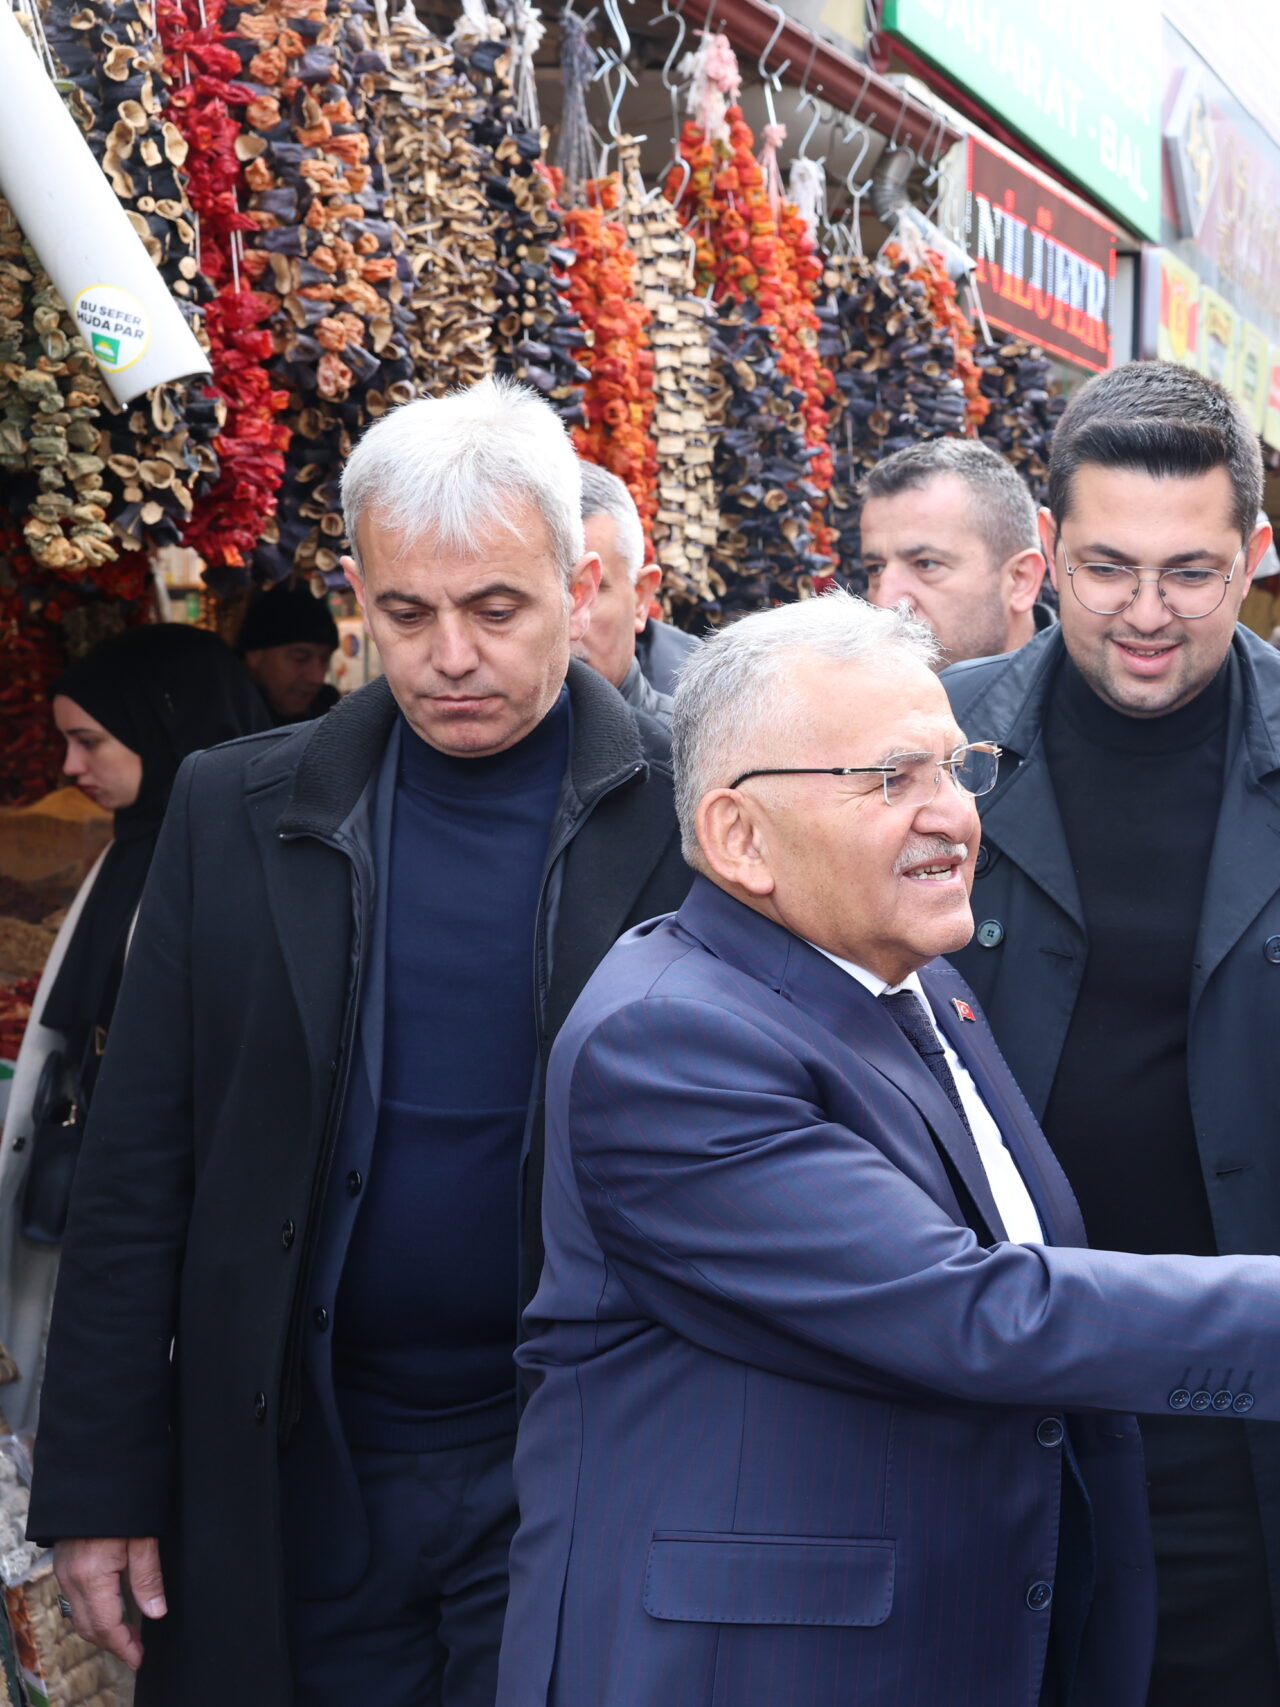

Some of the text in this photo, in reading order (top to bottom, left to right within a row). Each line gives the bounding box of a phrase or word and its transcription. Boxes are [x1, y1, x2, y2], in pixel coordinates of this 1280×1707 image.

[81, 300, 142, 325] BU SEFER
[114, 323, 144, 340] PAR
